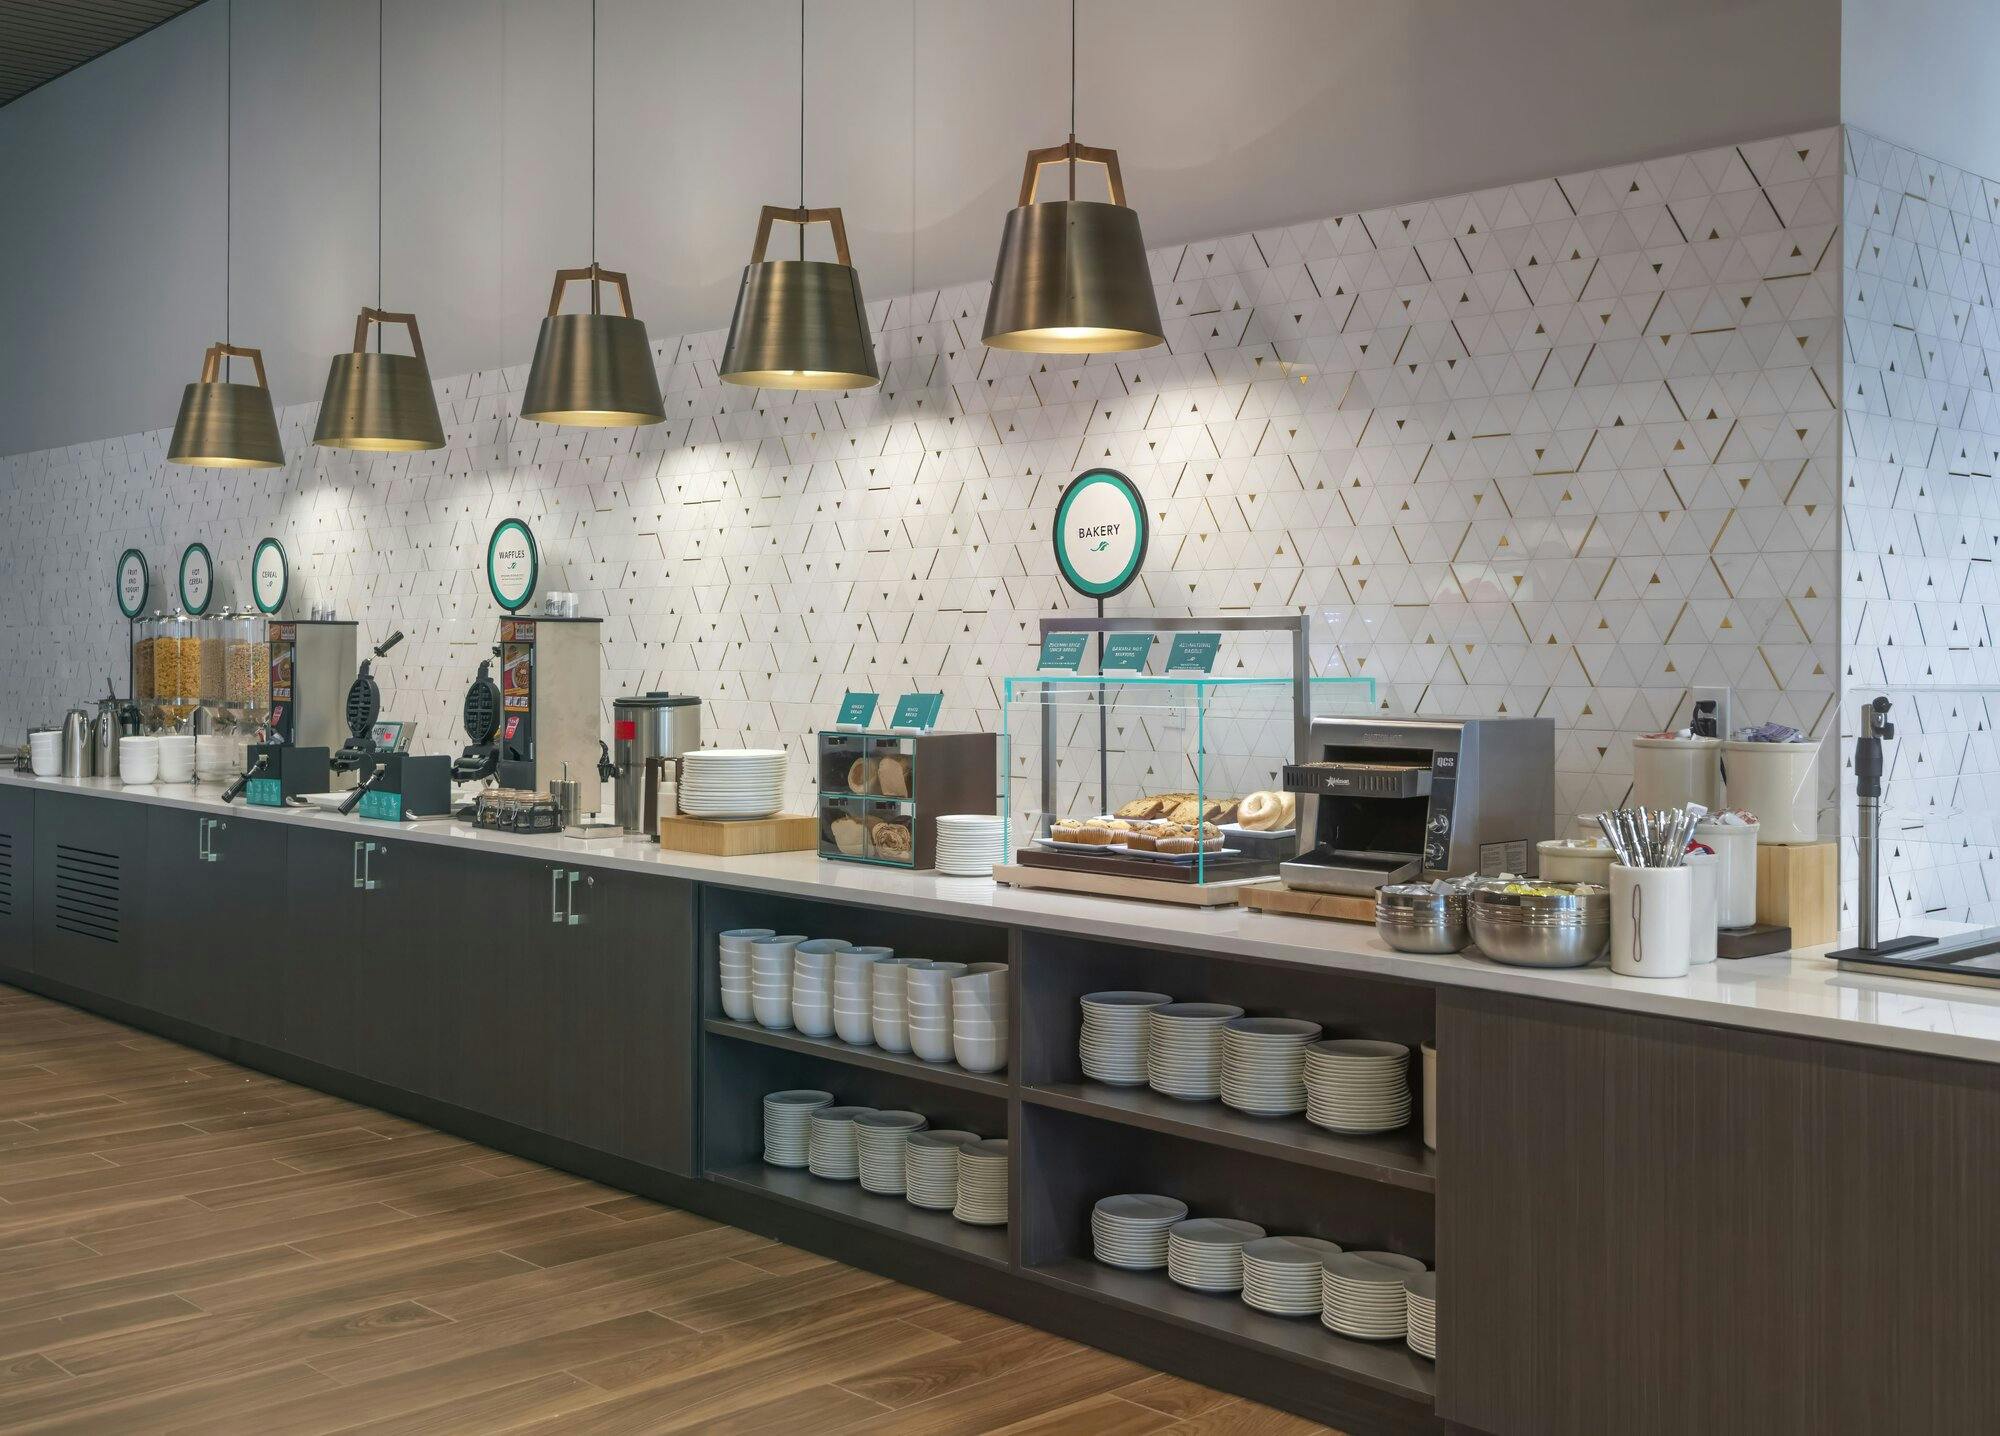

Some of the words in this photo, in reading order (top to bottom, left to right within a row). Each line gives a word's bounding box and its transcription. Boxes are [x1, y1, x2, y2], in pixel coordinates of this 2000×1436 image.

[1078, 524, 1121, 539] BAKERY
[498, 549, 525, 560] WAFFLES
[191, 568, 200, 576] HOT
[261, 570, 278, 579] CEREAL
[188, 578, 203, 586] CEREAL
[1436, 757, 1454, 768] QCS
